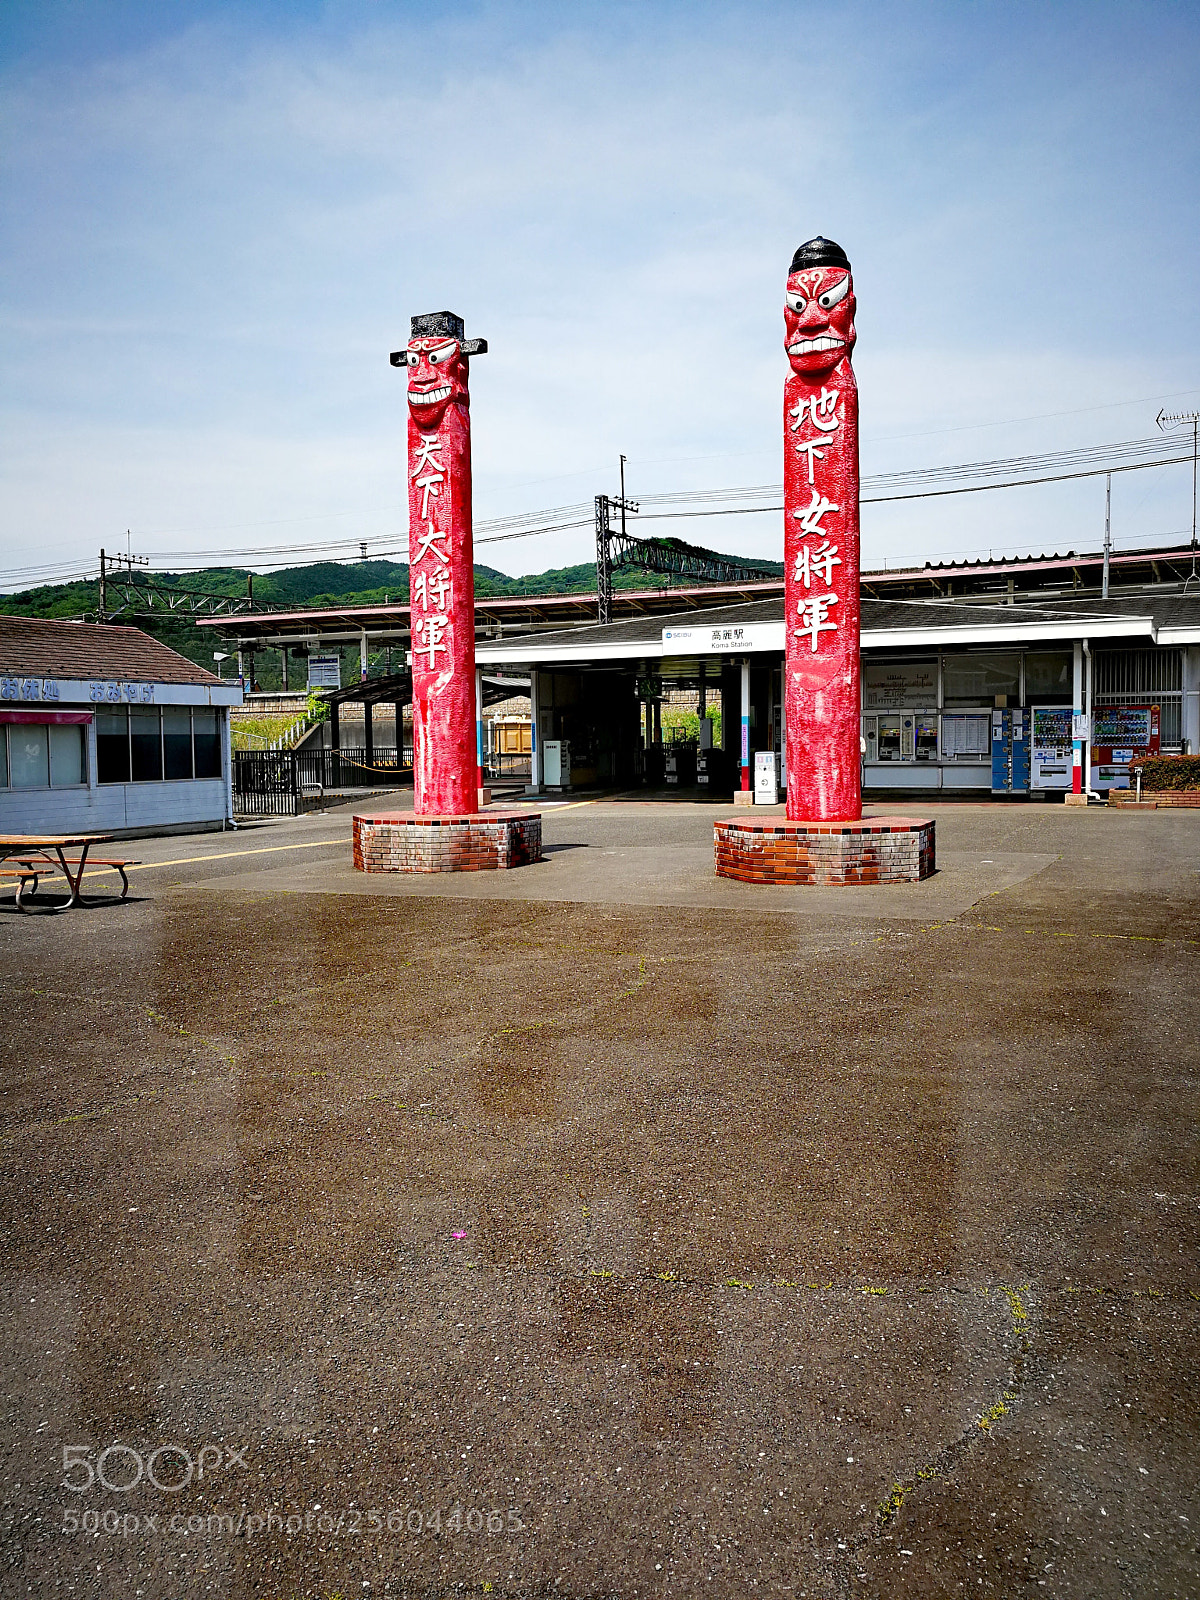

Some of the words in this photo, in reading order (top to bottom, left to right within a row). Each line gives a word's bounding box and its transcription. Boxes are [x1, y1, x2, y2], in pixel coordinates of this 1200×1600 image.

[711, 628, 744, 640] 高麗駅
[730, 640, 753, 648] Station
[1, 678, 59, 700] お休処
[90, 682, 154, 702] おみやげ
